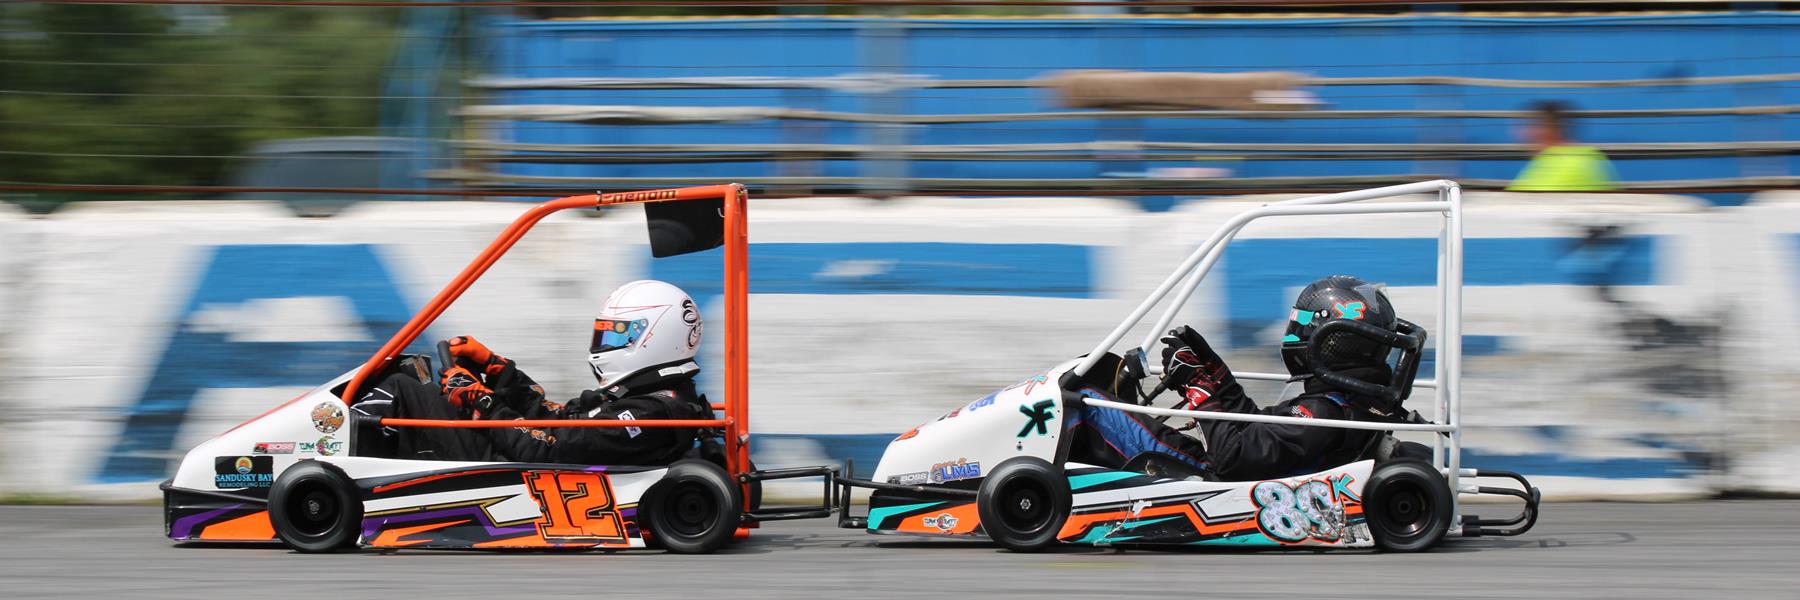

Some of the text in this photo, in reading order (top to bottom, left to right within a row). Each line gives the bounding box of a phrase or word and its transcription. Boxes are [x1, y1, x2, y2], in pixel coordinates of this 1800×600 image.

[215, 473, 273, 482] SANDUSKY BAY
[900, 473, 927, 482] BOSS
[522, 470, 630, 546] 12
